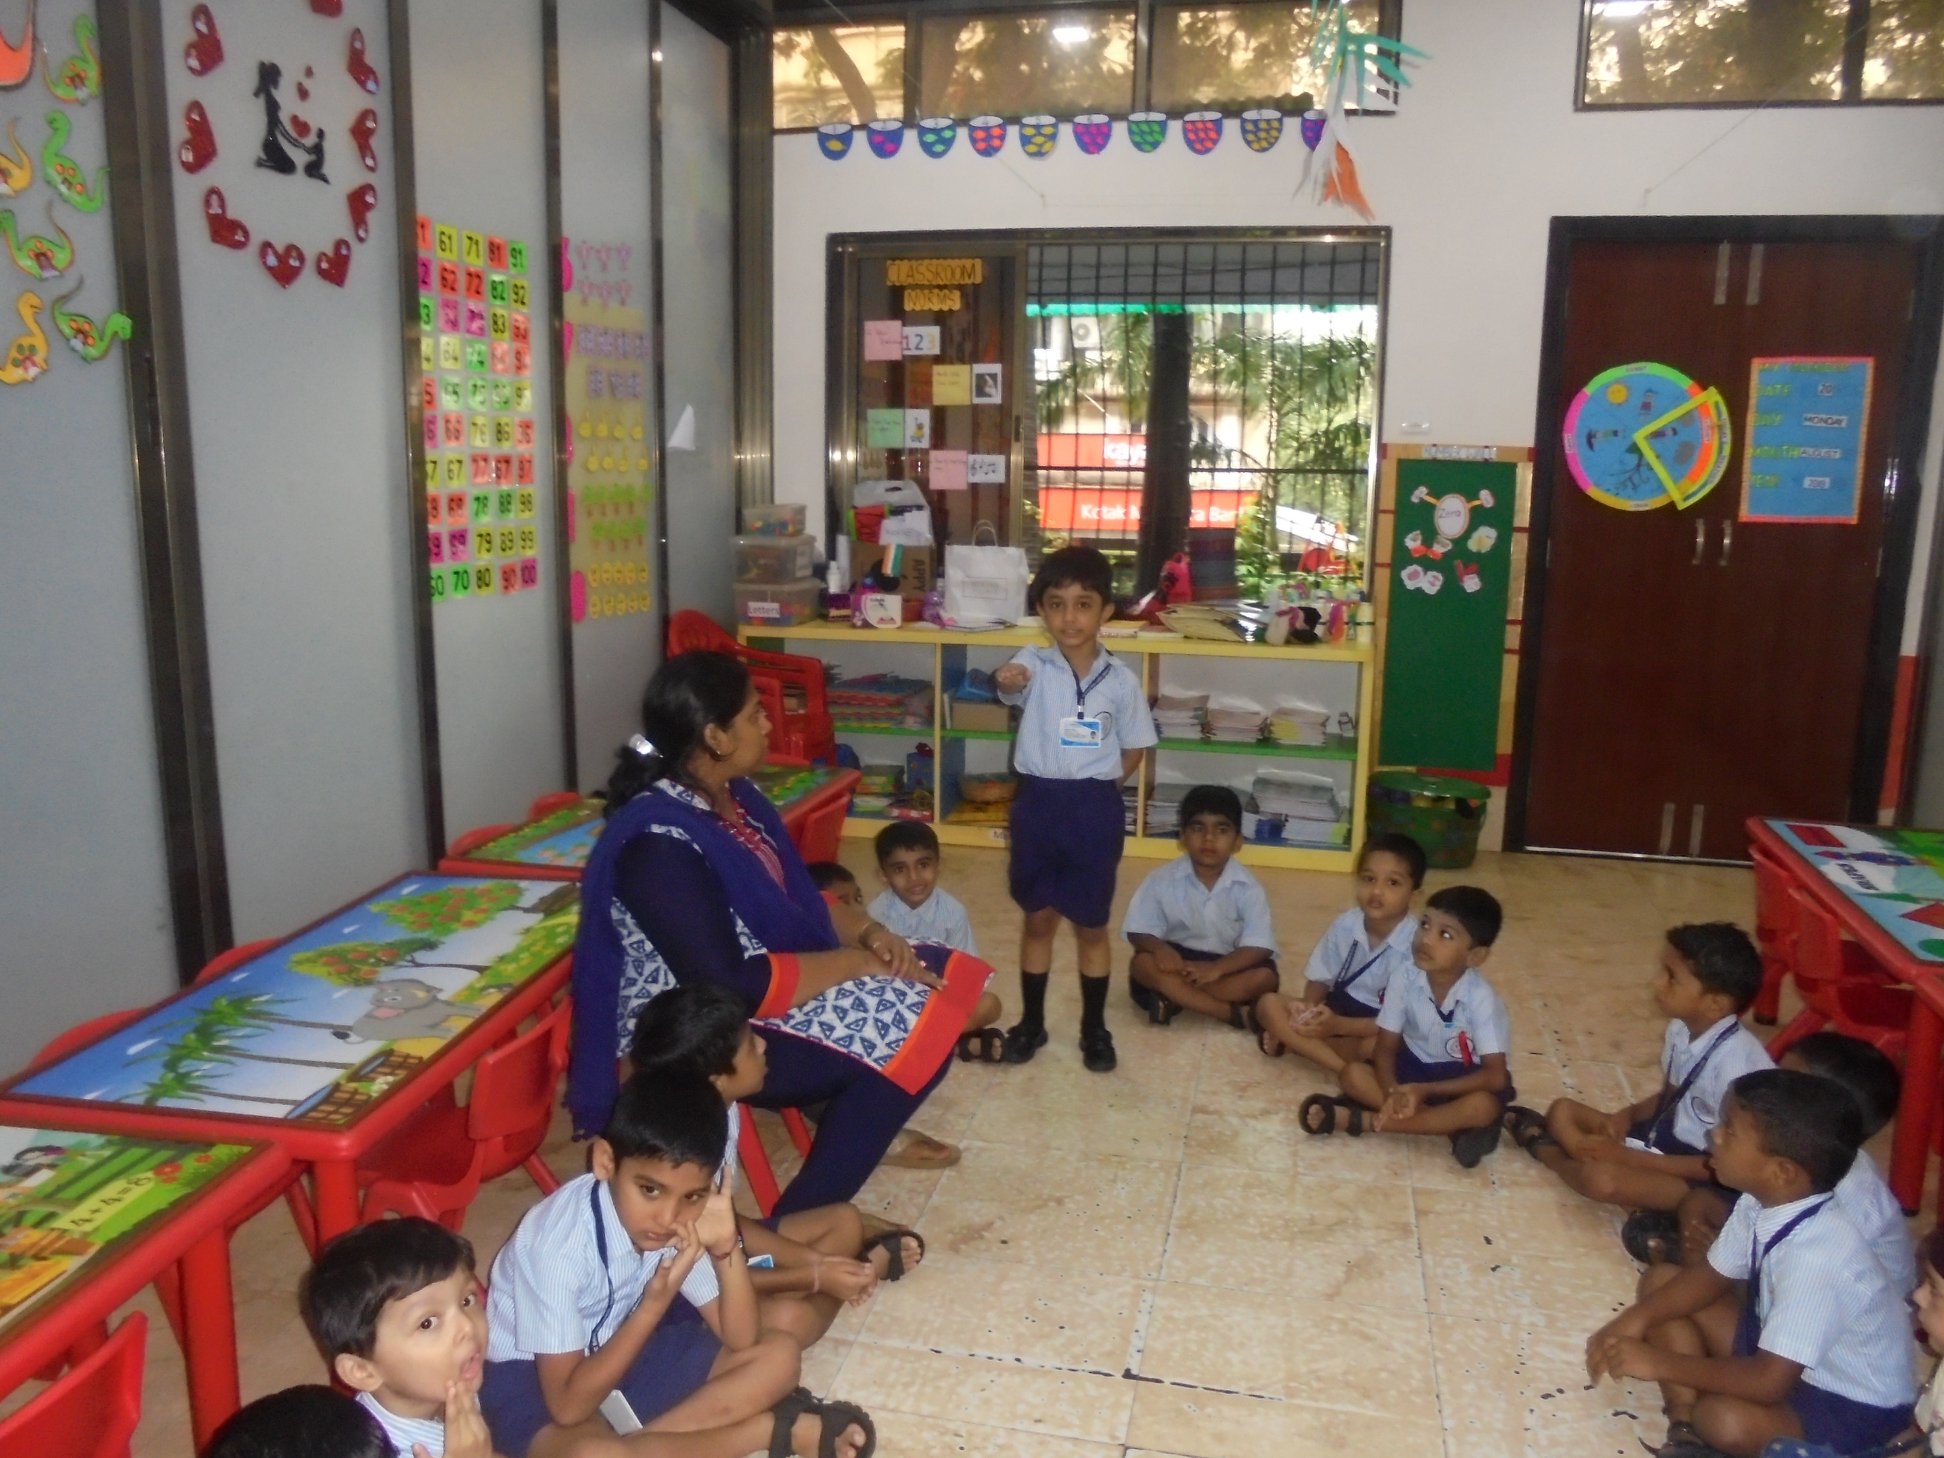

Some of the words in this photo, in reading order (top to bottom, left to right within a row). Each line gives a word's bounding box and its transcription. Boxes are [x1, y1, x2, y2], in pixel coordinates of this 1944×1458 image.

[439, 230, 453, 255] 61
[465, 234, 481, 260] 71
[510, 246, 524, 270] 91
[888, 262, 976, 283] CLASSROOM
[440, 266, 457, 293] 62
[466, 271, 482, 296] 72
[490, 279, 506, 301] 82
[512, 282, 526, 306] 92
[491, 311, 506, 334] 83
[1819, 382, 1833, 395] 20
[1803, 415, 1845, 426] MONDAY
[471, 421, 488, 444] 76
[496, 421, 511, 443] 86
[1801, 448, 1840, 458] AUGUST
[446, 458, 464, 481] 67
[473, 495, 489, 518] 78
[499, 492, 513, 515] 88
[519, 492, 534, 514] 98
[476, 532, 492, 555] 79
[500, 531, 514, 552] 89
[520, 530, 534, 550] 99
[453, 568, 469, 593] 70
[476, 567, 491, 590] 80
[502, 566, 518, 591] 90
